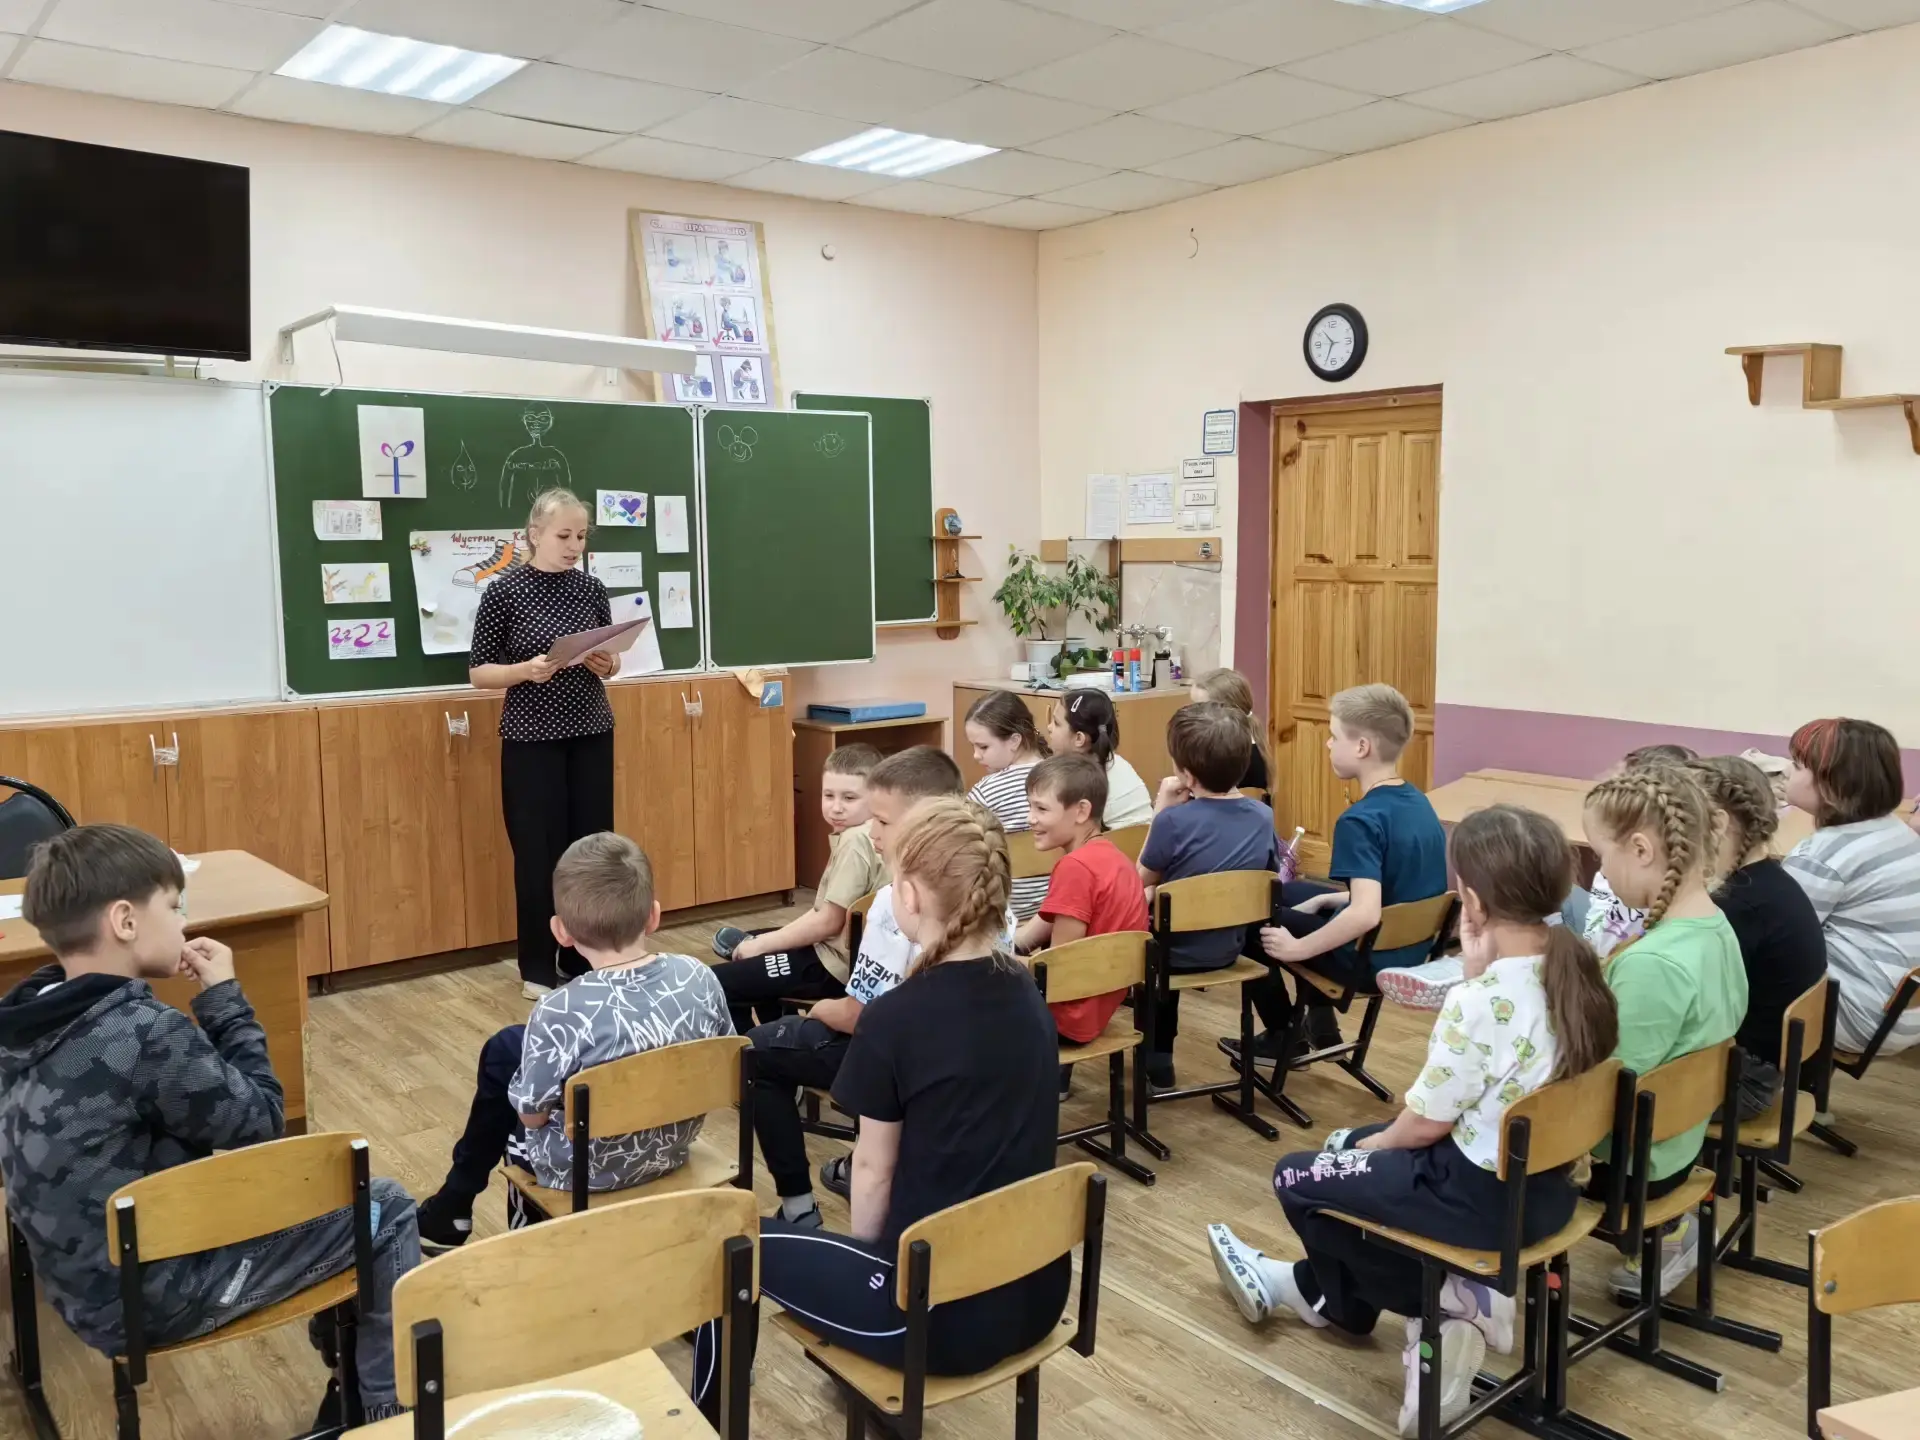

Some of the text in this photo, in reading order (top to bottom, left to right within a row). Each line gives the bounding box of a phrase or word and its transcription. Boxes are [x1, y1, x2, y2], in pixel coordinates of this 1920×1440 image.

[1328, 320, 1337, 328] 12
[1314, 337, 1352, 349] 9 3
[1330, 357, 1337, 366] 6
[450, 532, 495, 548] Шустрые
[855, 966, 880, 989] DAY
[850, 977, 875, 1000] OOD
